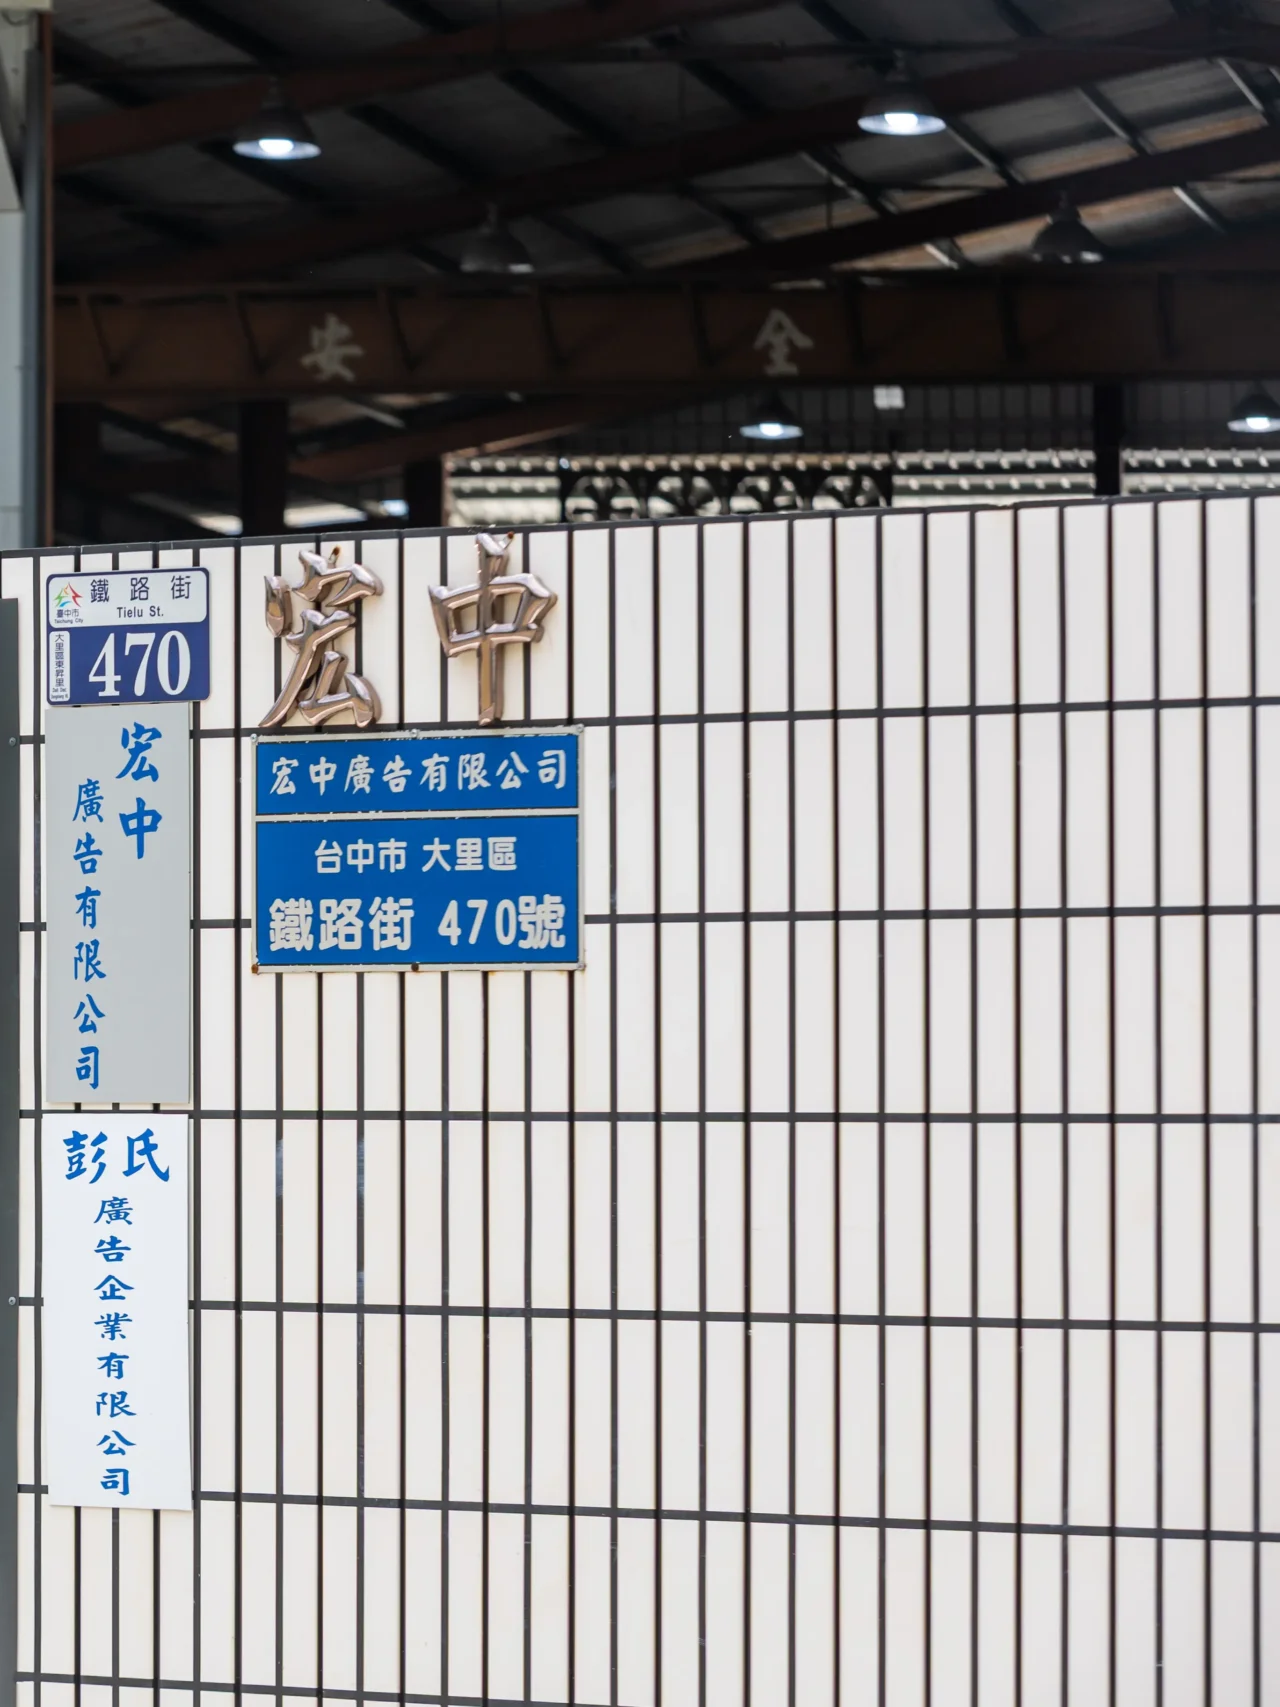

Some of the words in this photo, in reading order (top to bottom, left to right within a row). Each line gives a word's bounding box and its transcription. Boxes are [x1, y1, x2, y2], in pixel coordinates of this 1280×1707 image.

[301, 312, 364, 383] 安
[754, 308, 814, 375] 全
[90, 575, 192, 603] 鐵路街
[117, 607, 143, 618] Tielu
[149, 605, 164, 618] St.
[88, 630, 191, 697] 470
[115, 722, 162, 860] 宏中
[270, 749, 566, 796] 宏中廣告有限公司
[314, 837, 407, 874] 台中市
[421, 836, 518, 872] 大里區
[72, 778, 106, 1090] 廣告有限公司
[269, 896, 415, 951] 鐵路街
[437, 894, 567, 949] 470號
[62, 1128, 170, 1184] 彭氏
[93, 1196, 137, 1496] 廣告企業有限公司
